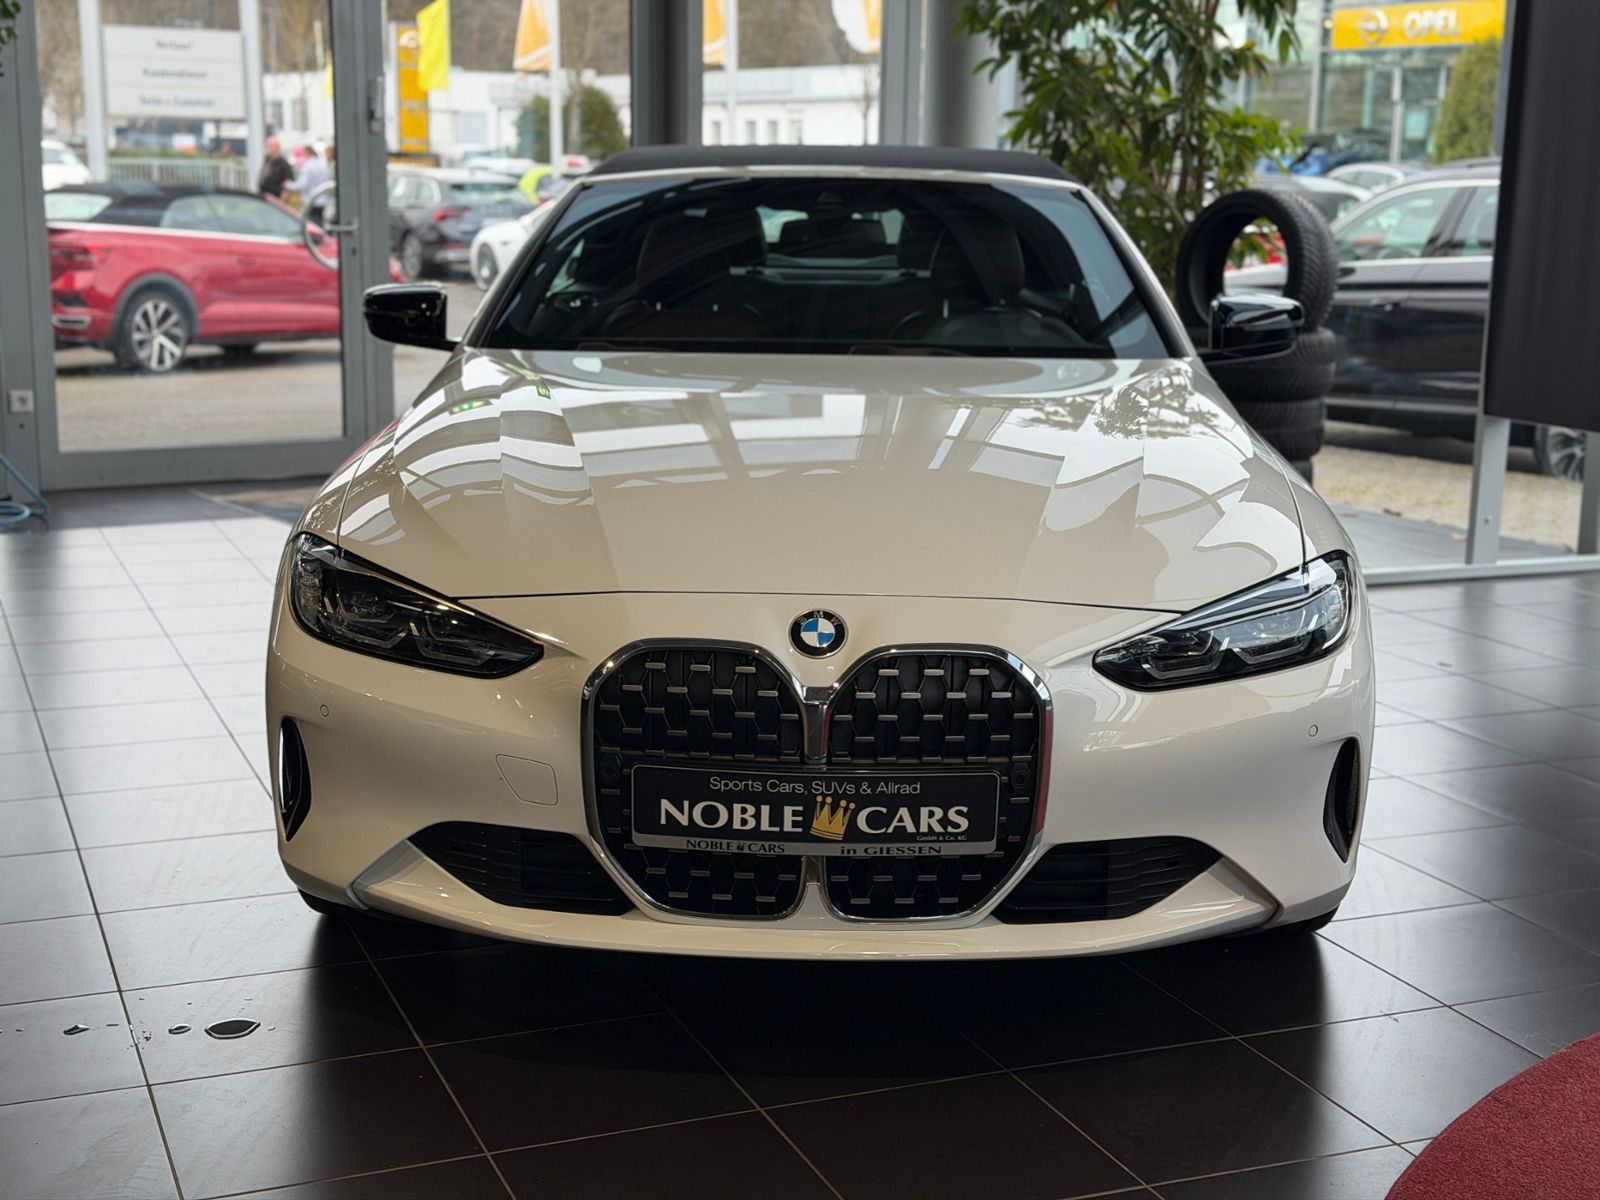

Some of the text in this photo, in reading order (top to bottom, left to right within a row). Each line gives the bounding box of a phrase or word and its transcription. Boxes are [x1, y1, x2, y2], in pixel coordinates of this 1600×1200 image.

[1404, 8, 1462, 39] OPEL
[797, 611, 842, 626] BMW
[709, 776, 921, 795] Sports Cars, SUVs & Allrad
[659, 798, 970, 834] NOBLE CARS
[686, 839, 786, 853] NOBLE CARS
[840, 846, 942, 855] in GIESSEN
